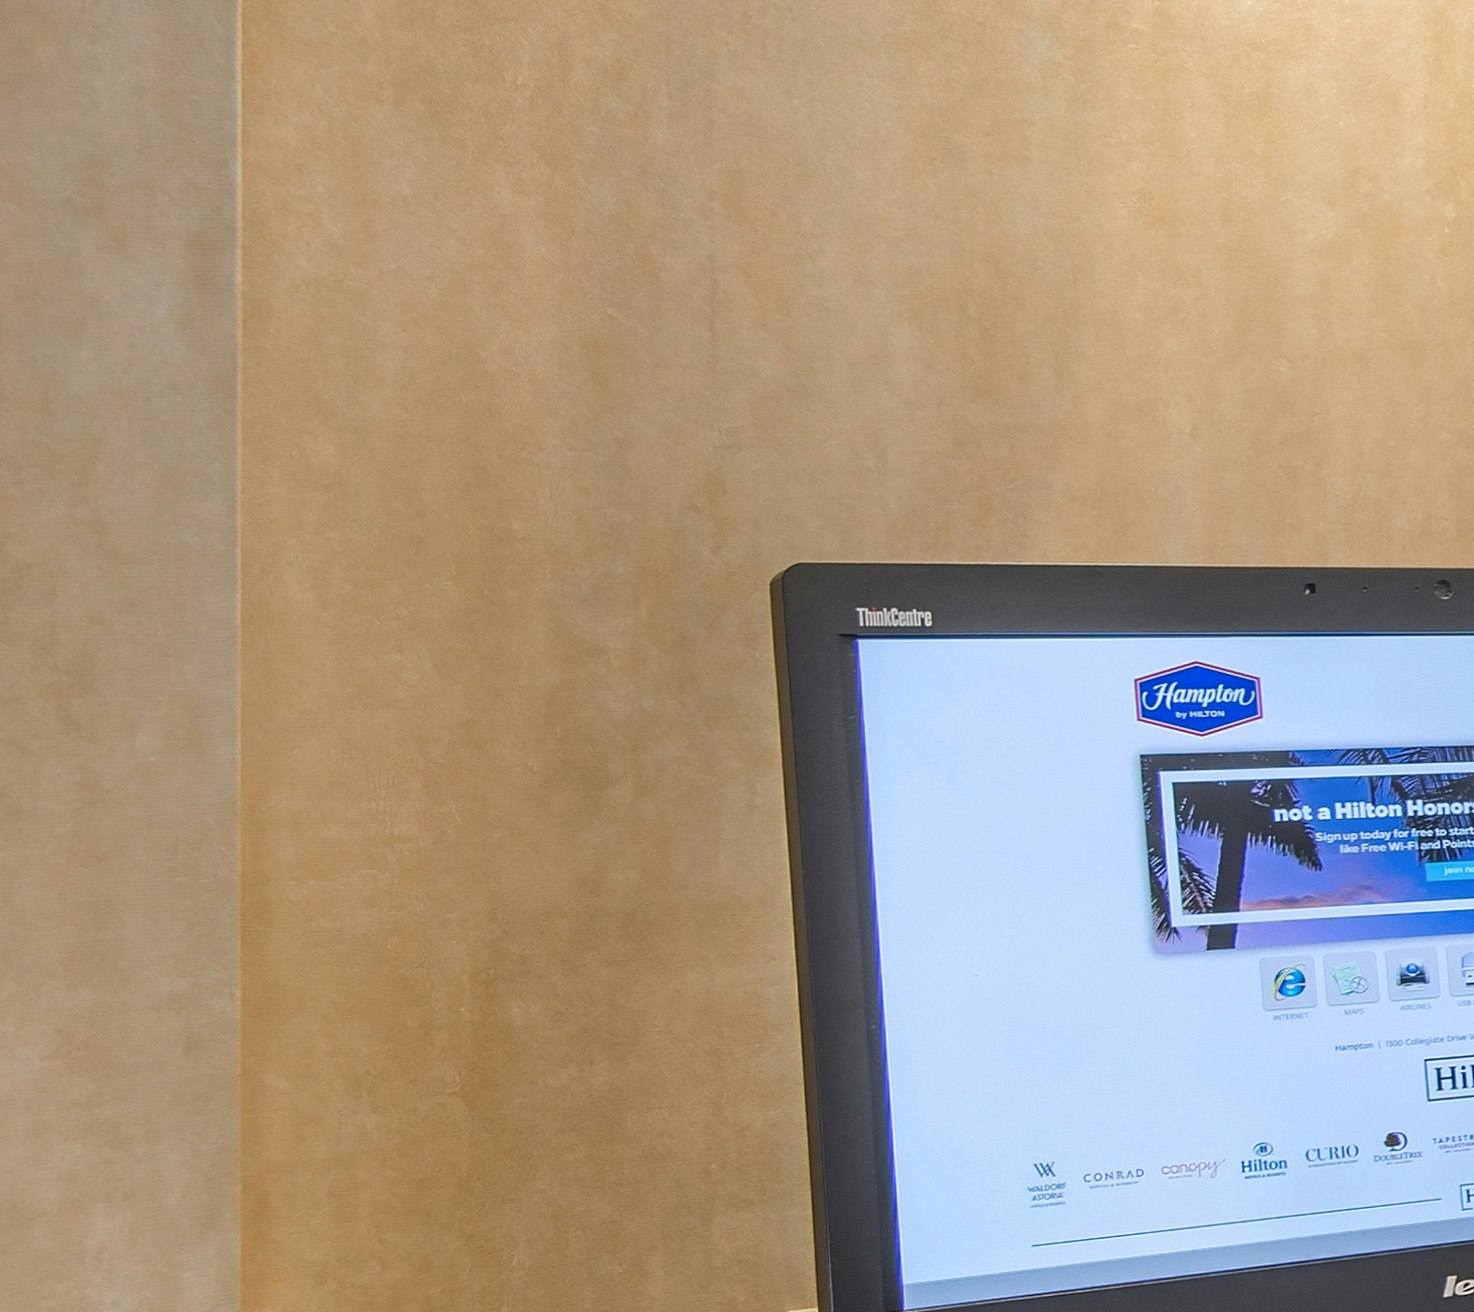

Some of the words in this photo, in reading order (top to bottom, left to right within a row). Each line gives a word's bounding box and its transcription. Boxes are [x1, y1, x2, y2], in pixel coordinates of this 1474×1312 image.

[856, 607, 933, 627] ThinkCentre
[1142, 683, 1254, 710] Hampton
[1176, 711, 1187, 719] by
[1273, 806, 1313, 822] not
[1317, 807, 1331, 820] a
[1335, 801, 1402, 819] Hilton
[1315, 832, 1343, 844] Sign
[1344, 832, 1358, 842] up
[1360, 829, 1391, 841] today
[1393, 828, 1410, 838] for
[1411, 827, 1434, 838] free
[1435, 827, 1447, 837] to
[1340, 844, 1360, 854] like
[1361, 843, 1387, 853] Free
[1389, 841, 1419, 852] Wi-Fi
[1420, 840, 1441, 850] and
[1443, 865, 1463, 876] join
[1305, 1144, 1360, 1163] CURIO
[1240, 1159, 1288, 1174] Hilton
[1083, 1168, 1145, 1184] CONRAD
